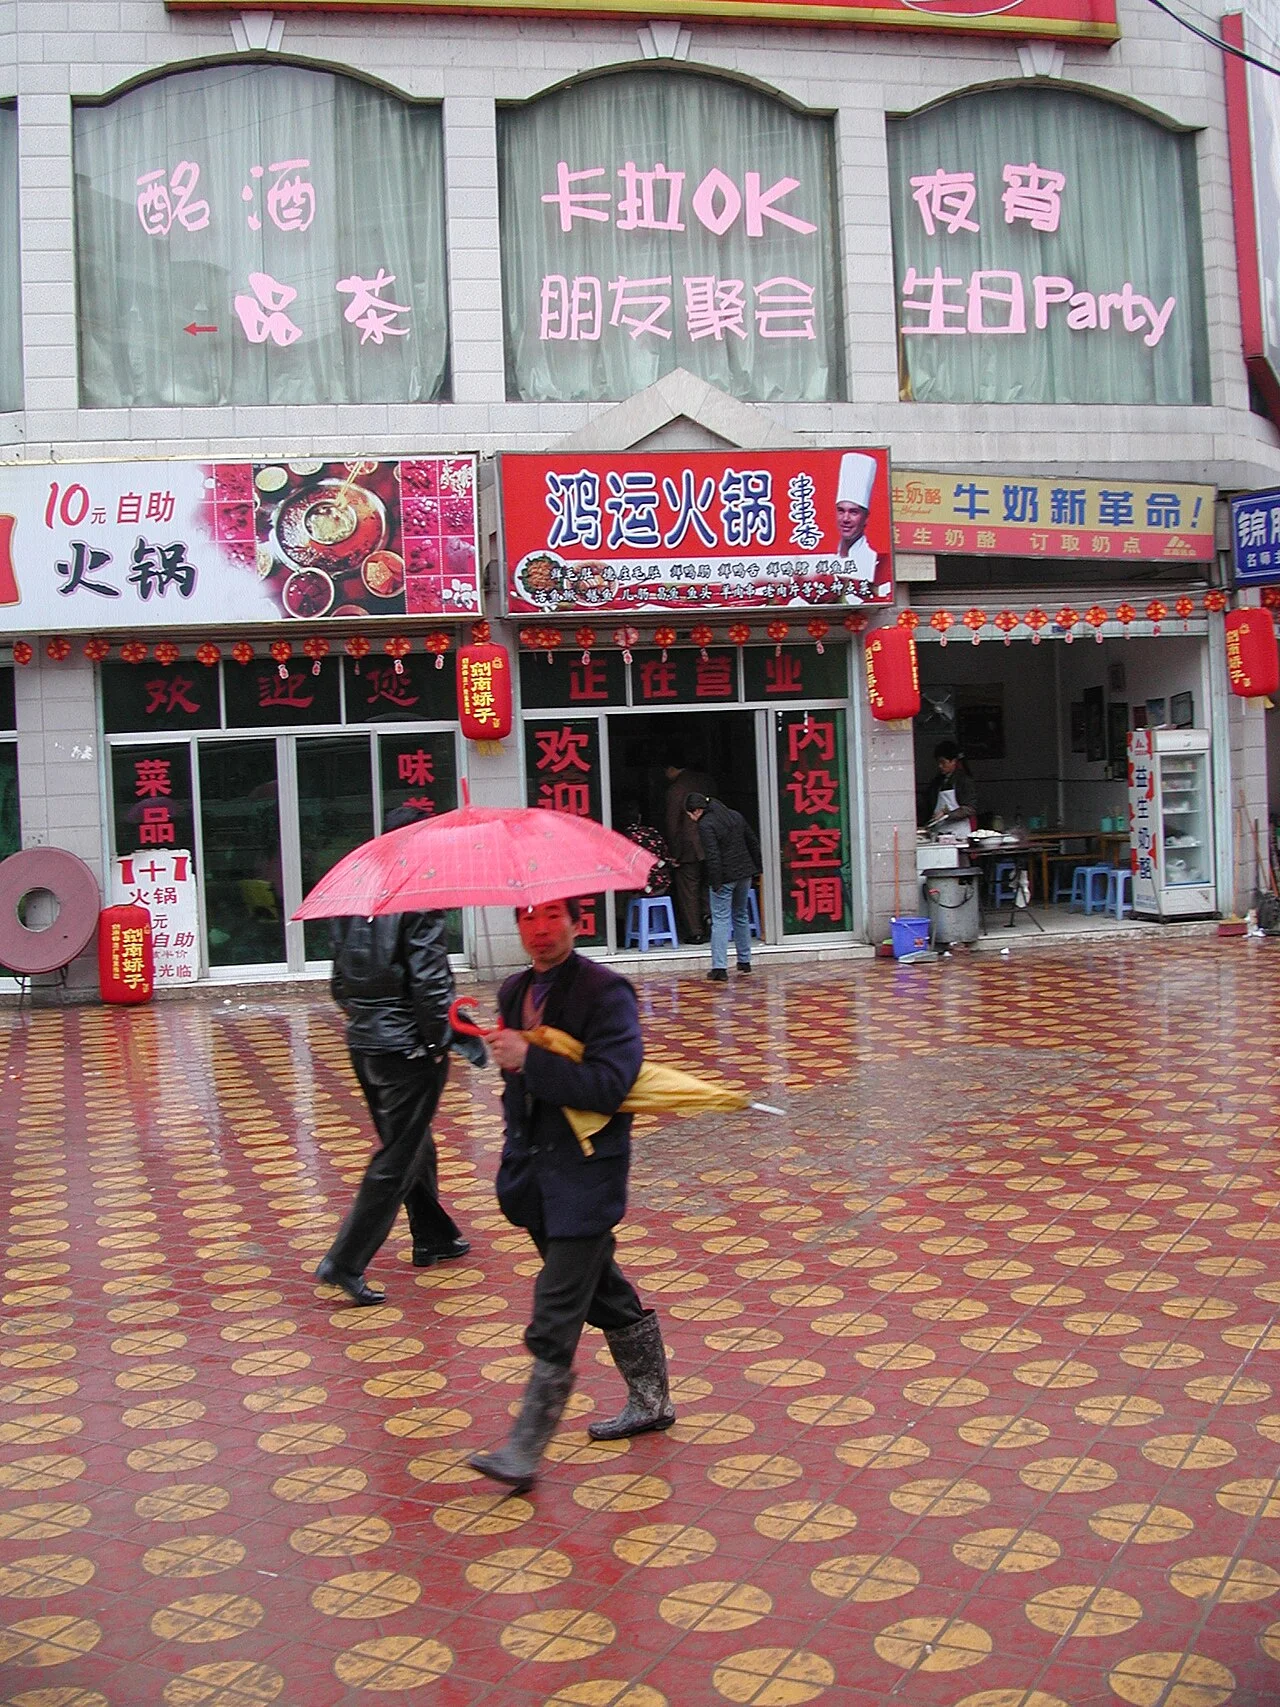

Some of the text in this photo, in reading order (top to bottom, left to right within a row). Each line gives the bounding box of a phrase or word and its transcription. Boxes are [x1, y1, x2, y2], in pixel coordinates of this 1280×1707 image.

[541, 161, 818, 237] 卡拉OK
[909, 162, 1066, 235] 夜宵
[234, 268, 411, 347] 品茶
[539, 274, 818, 343] 朋友聚会
[901, 266, 1177, 347] 生日Party
[545, 469, 778, 549] 鸿运火锅
[788, 473, 825, 549] 串串香
[953, 483, 1203, 529] 牛奶新革命!
[56, 537, 198, 602] 火锅
[1030, 532, 1142, 554] 订取奶点
[569, 656, 803, 700] 正在营业
[135, 759, 174, 843] 菜品
[787, 719, 842, 922] 内设空调
[1135, 764, 1153, 881] 益生奶酪
[129, 886, 178, 906] 火锅
[151, 963, 192, 979] 光临
[153, 931, 195, 948] 自助
